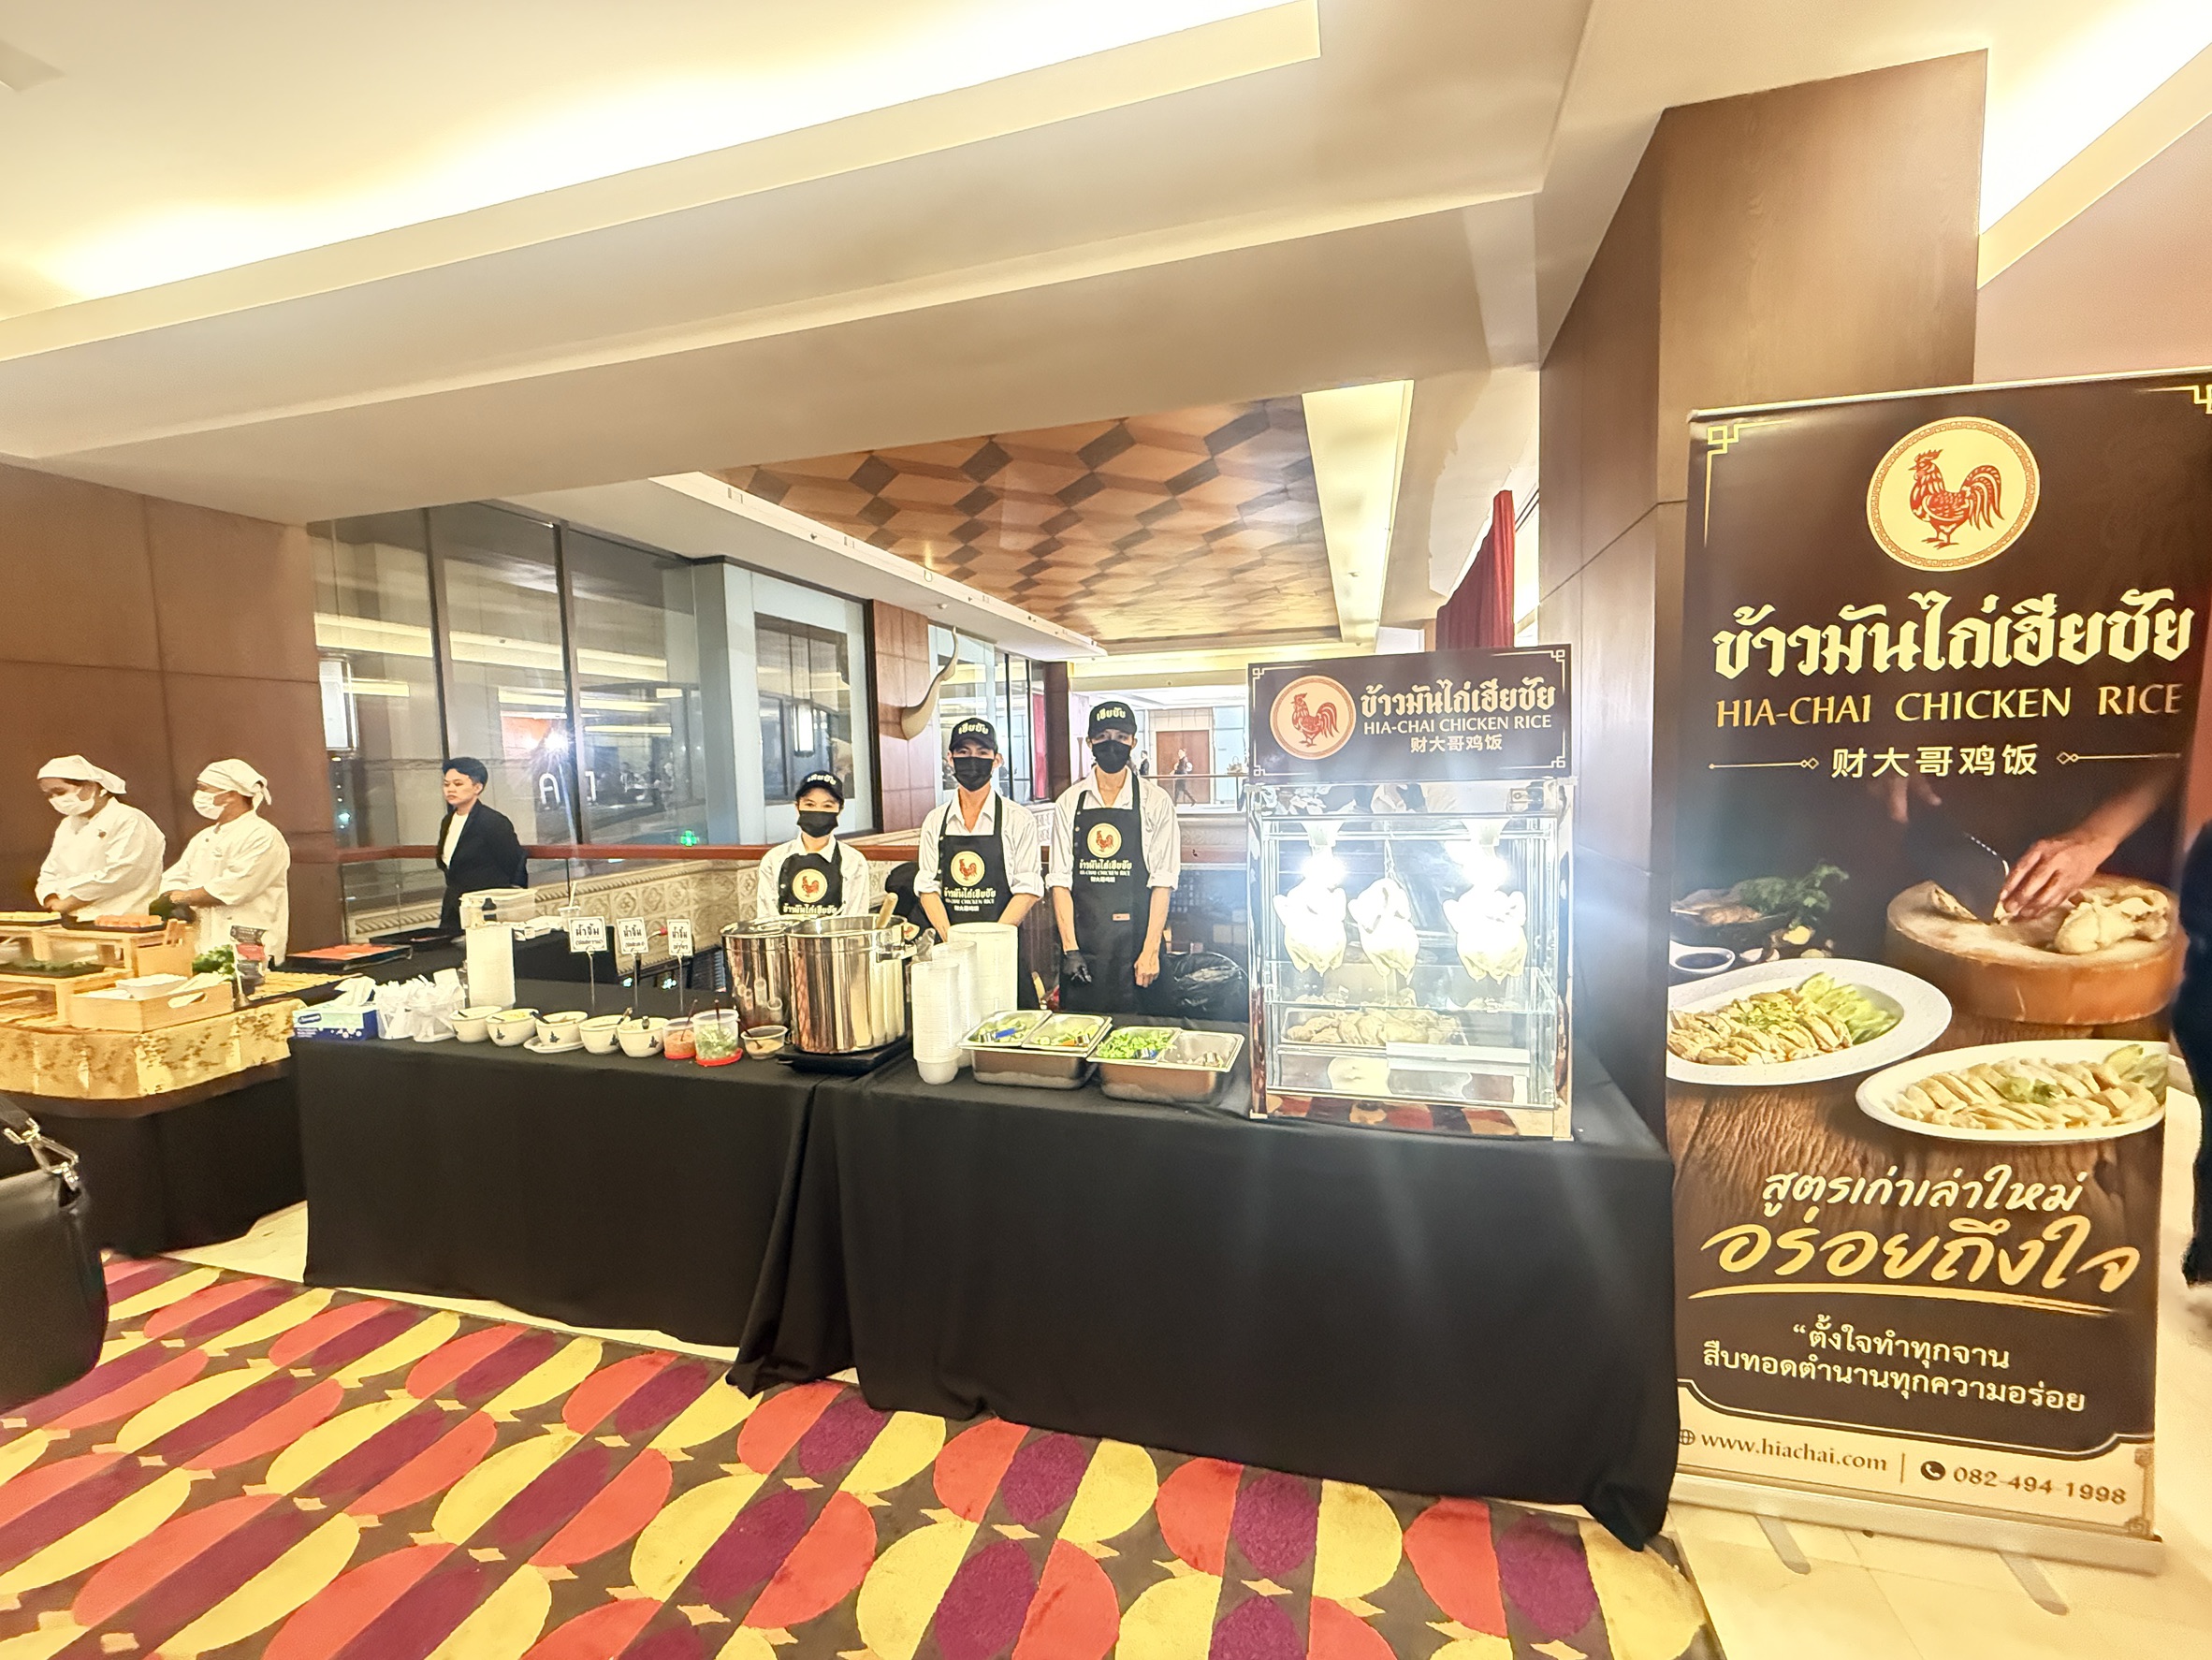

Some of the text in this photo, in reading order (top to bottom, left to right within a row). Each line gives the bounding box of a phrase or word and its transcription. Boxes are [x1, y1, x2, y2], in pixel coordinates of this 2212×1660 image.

[1711, 588, 2195, 680] ข้าวมันไก่เฮียชัย
[1360, 676, 1557, 719] ข้าวมันไก่เฮียชัย
[1715, 683, 2184, 728] HIA-CHAI CHICKEN RICE
[1363, 714, 1552, 735] HIA-CHAI CHICKEN RICE
[1410, 734, 1503, 753] 财大哥鸡饭
[1830, 743, 2040, 779] 财大哥鸡饭
[1762, 1164, 2088, 1218] สูตรเก่าเล่าใหม่
[1700, 1207, 2141, 1293] อร่อยถึงใจ
[1703, 1339, 2086, 1412] สืบทอดตำนานทุกความอร่อย
[1700, 1437, 1887, 1472] www.hiachai.com
